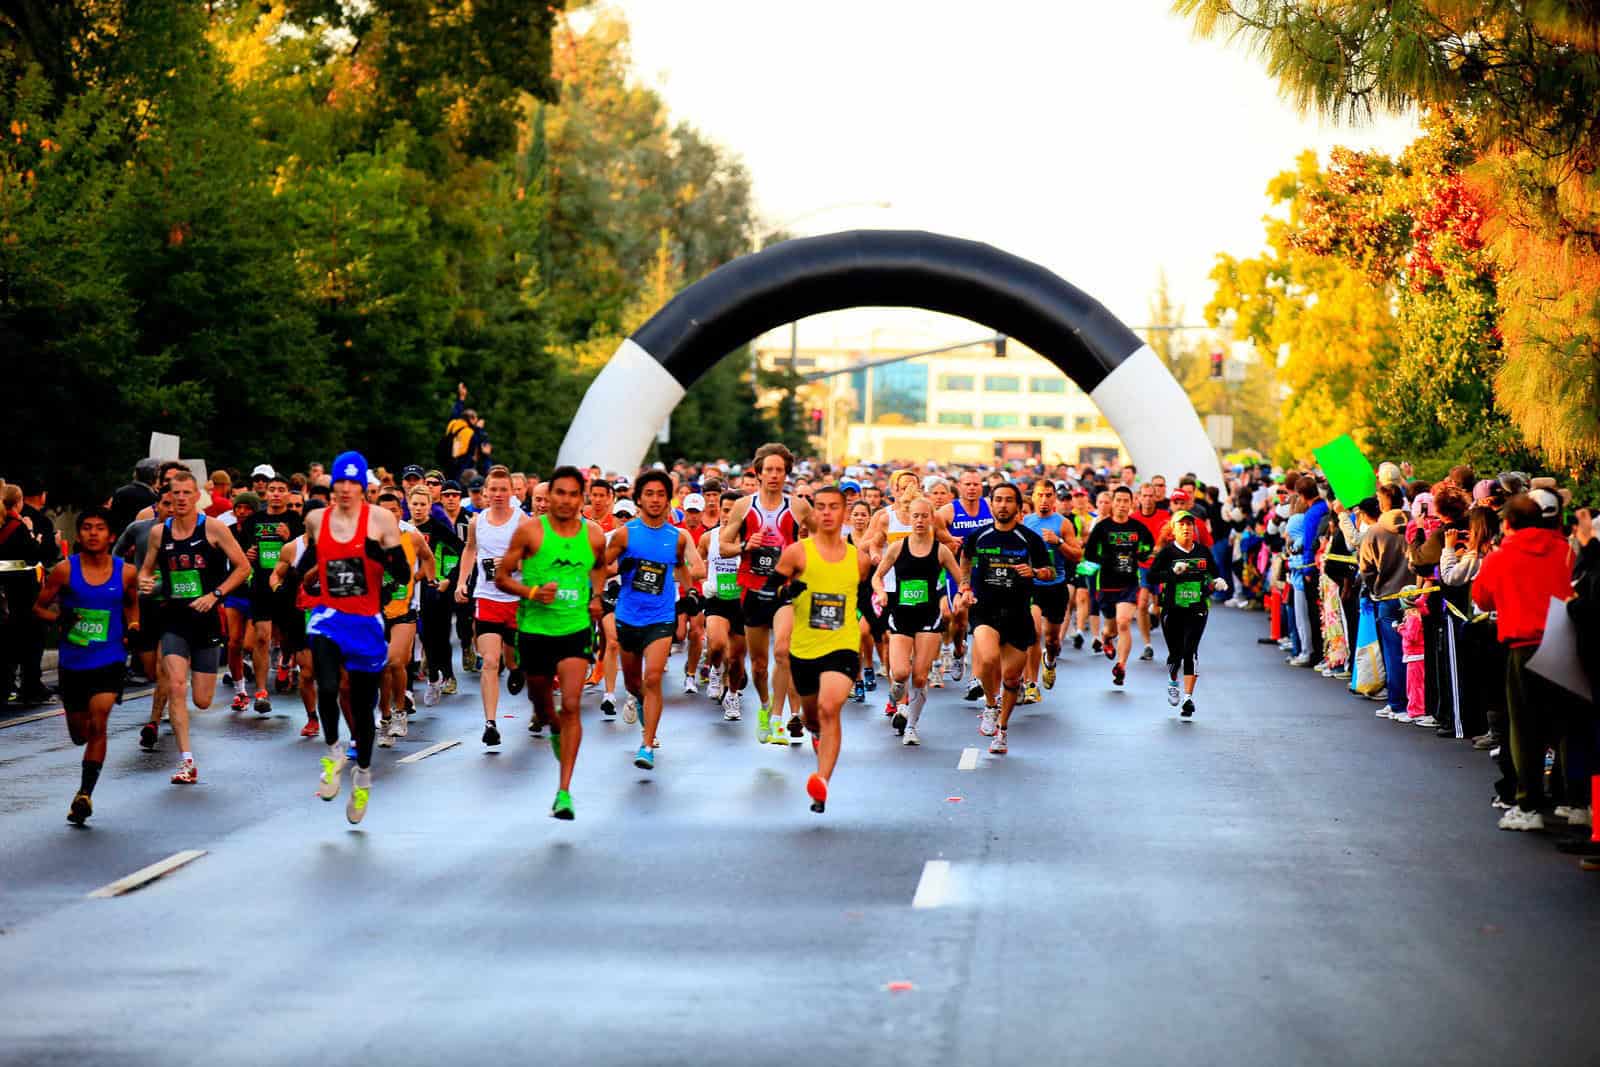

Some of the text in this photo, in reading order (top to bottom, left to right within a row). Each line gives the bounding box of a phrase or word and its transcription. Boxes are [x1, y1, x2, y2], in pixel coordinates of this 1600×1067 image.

[759, 556, 772, 566] 69
[643, 572, 657, 582] 63
[995, 568, 1008, 577] 64
[337, 572, 355, 584] 72
